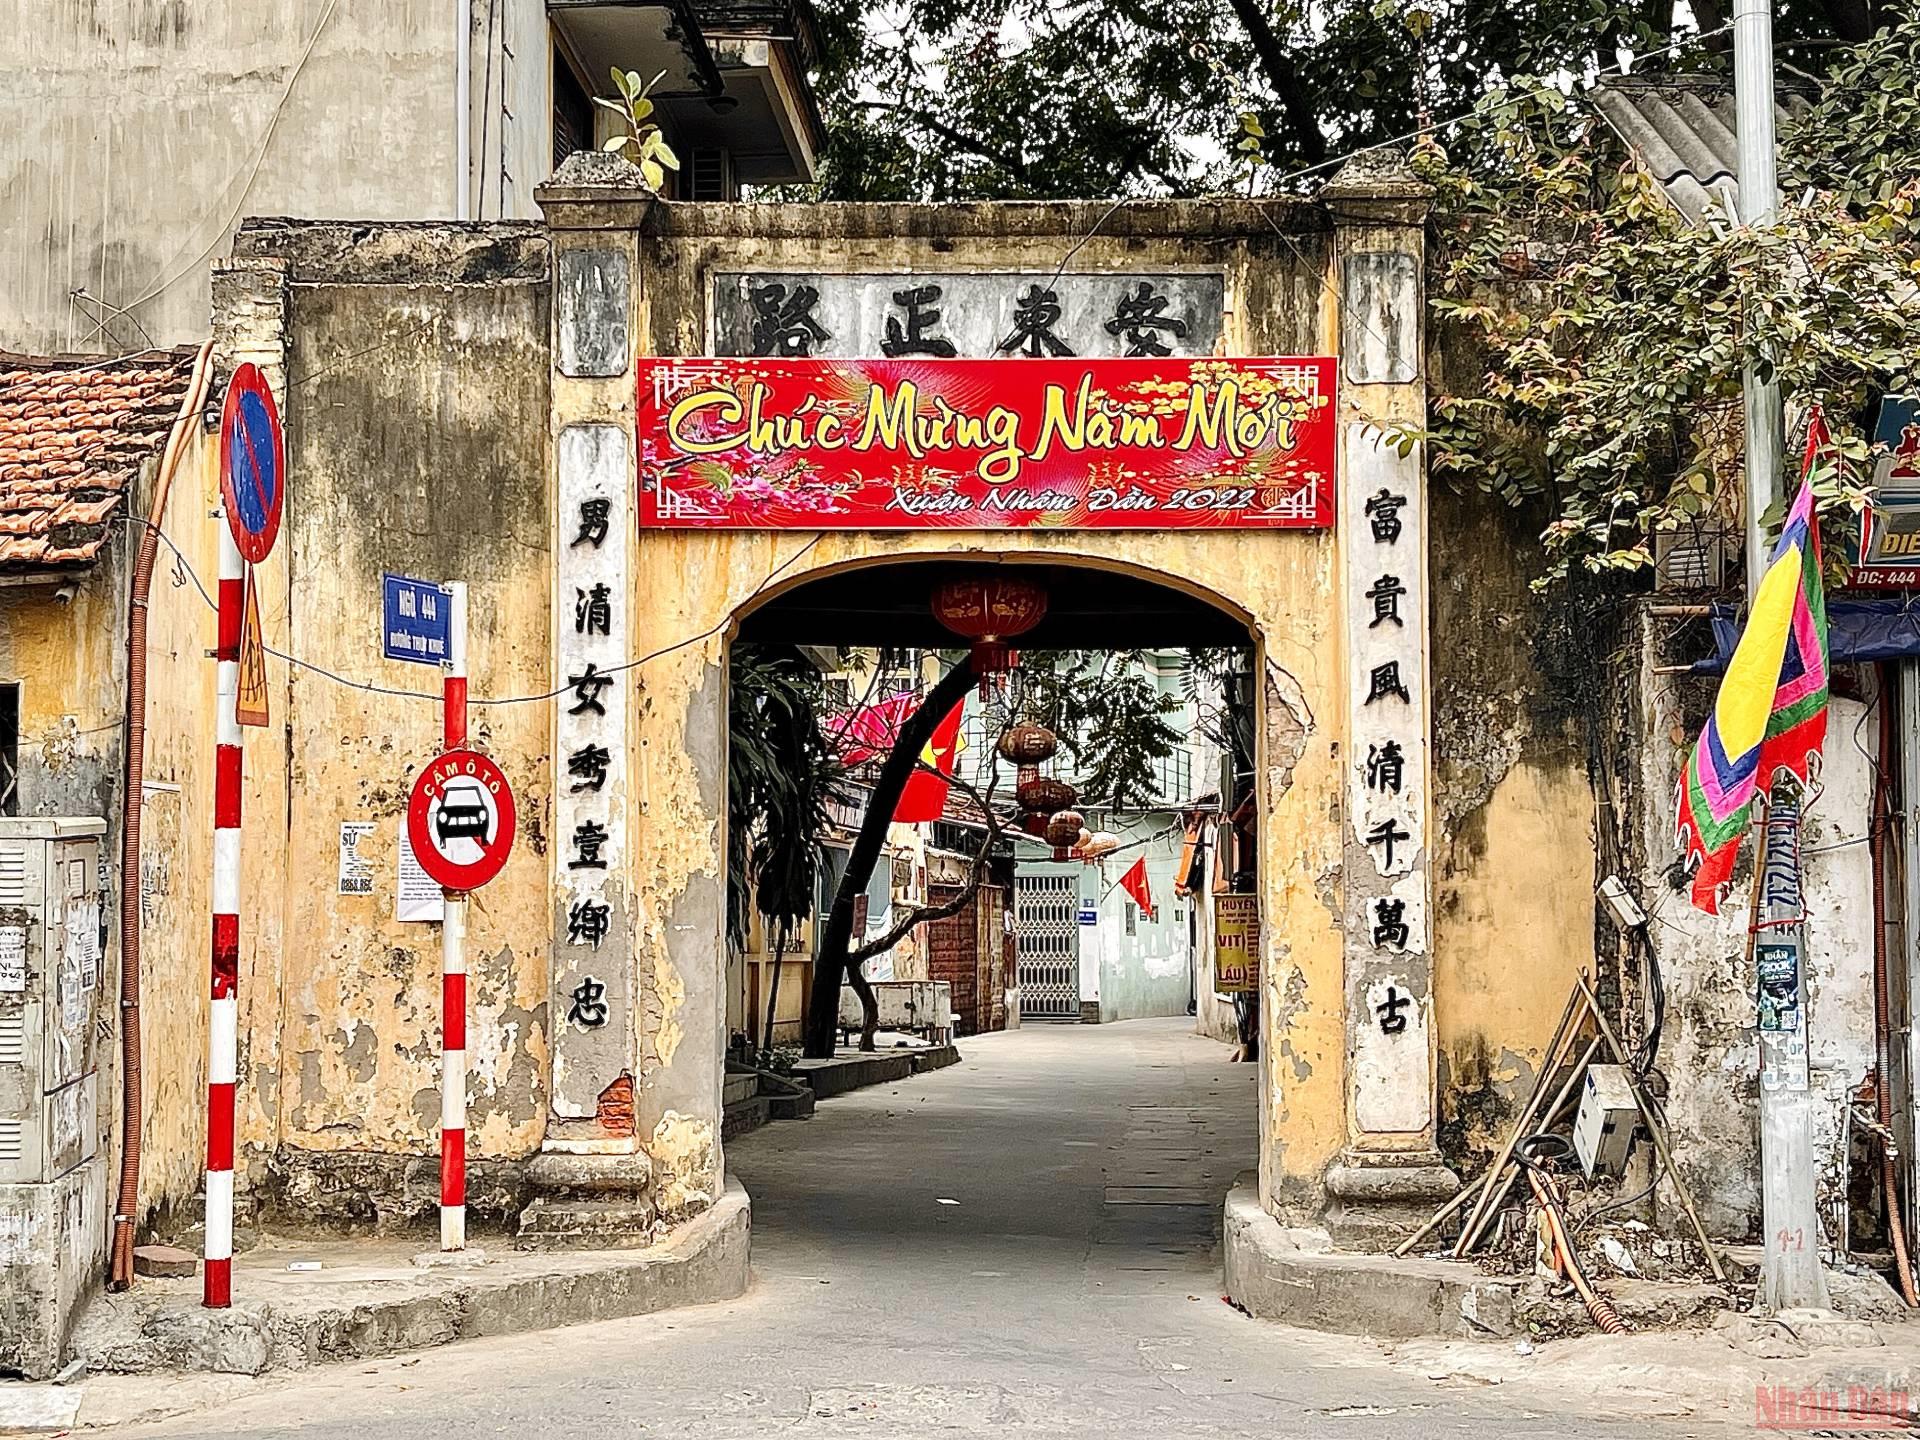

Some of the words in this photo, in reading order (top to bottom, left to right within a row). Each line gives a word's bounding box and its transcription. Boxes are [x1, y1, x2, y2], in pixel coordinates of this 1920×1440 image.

[668, 381, 846, 454] Chúc
[851, 378, 1027, 486] Mừng
[1033, 370, 1166, 461] Năm
[1166, 377, 1295, 456] Mới
[884, 487, 972, 513] Xuân
[979, 487, 1079, 512] Nhâm
[1161, 488, 1257, 510] 2022
[1857, 571, 1884, 585] ĐC:
[1887, 571, 1916, 585] 444
[421, 593, 436, 621] 444
[423, 761, 459, 798] CẤM
[466, 758, 476, 775] Ô
[482, 769, 501, 795] TÔ
[1218, 934, 1241, 950] VỊT
